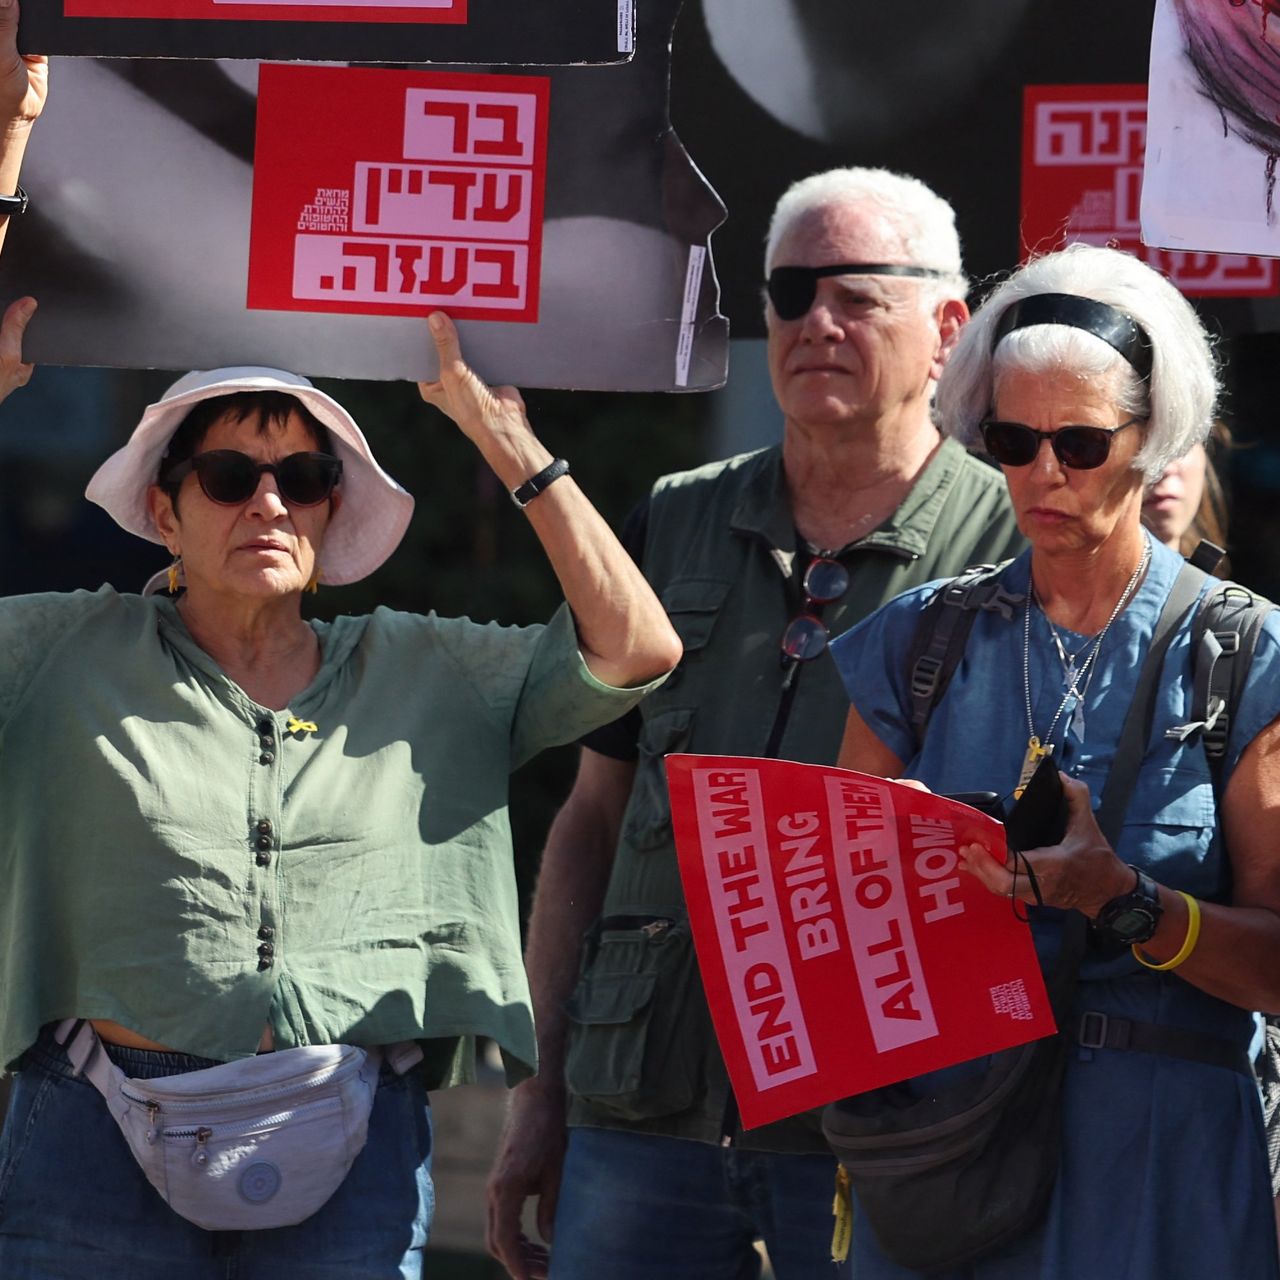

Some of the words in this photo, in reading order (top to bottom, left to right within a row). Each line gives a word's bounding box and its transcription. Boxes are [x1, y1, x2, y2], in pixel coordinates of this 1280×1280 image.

[424, 101, 524, 157] בר
[315, 196, 350, 208] הנשים
[317, 188, 350, 198] מחאת
[365, 167, 523, 226] עדיין
[320, 242, 520, 299] בעזה.
[708, 771, 750, 839] WAR
[840, 781, 885, 840] THEM
[717, 845, 770, 953] THE
[776, 810, 841, 961] BRING
[849, 848, 893, 910] OF
[910, 813, 966, 924] HOME
[865, 918, 923, 1021] ALL
[742, 961, 803, 1078] END
